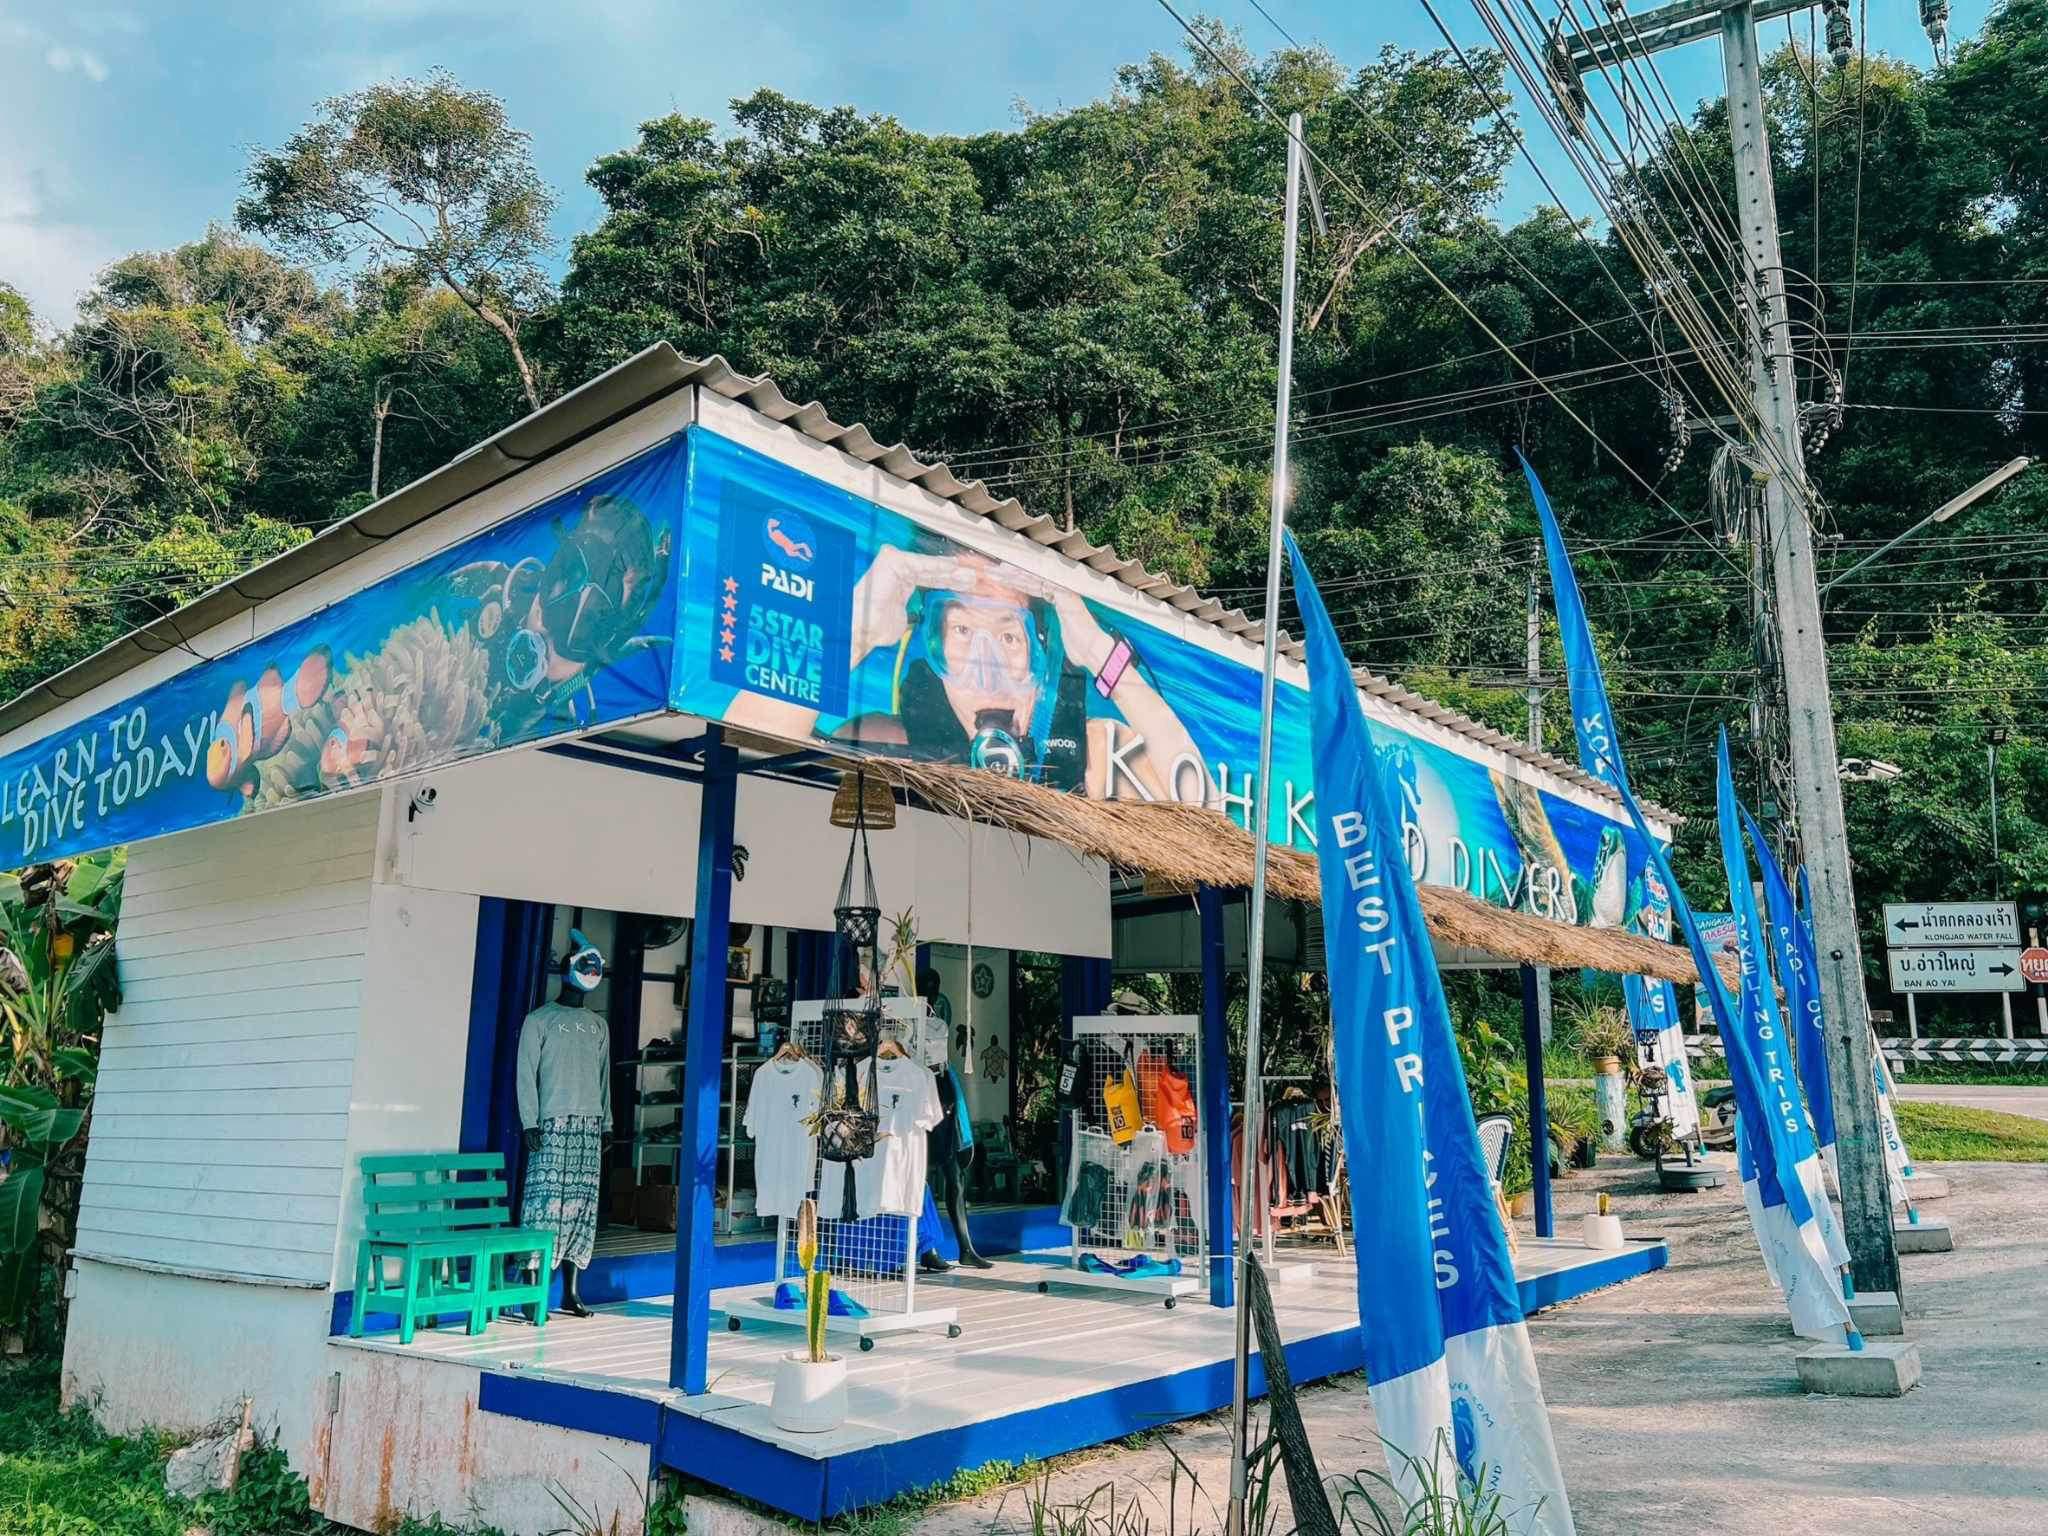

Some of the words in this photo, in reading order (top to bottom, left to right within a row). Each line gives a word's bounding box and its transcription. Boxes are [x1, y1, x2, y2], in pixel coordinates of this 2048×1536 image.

[760, 563, 815, 602] PADI
[744, 664, 821, 703] CENTRE
[746, 628, 823, 683] DIVE
[1, 732, 97, 825] LEARN
[109, 706, 147, 763] TO
[23, 780, 87, 857] DIVE
[97, 710, 218, 817] TODAY!
[1104, 721, 1253, 831] KOH
[1447, 836, 1578, 926] DIVERS
[1332, 811, 1397, 976] BEST
[1780, 926, 1806, 986] PADI
[1967, 933, 1993, 941] WATER
[1996, 932, 2015, 940] FALL
[1904, 979, 1922, 988] BAN
[1926, 979, 1938, 988] AO
[1765, 1050, 1799, 1133] TRIPS
[1383, 1006, 1460, 1290] PRES
